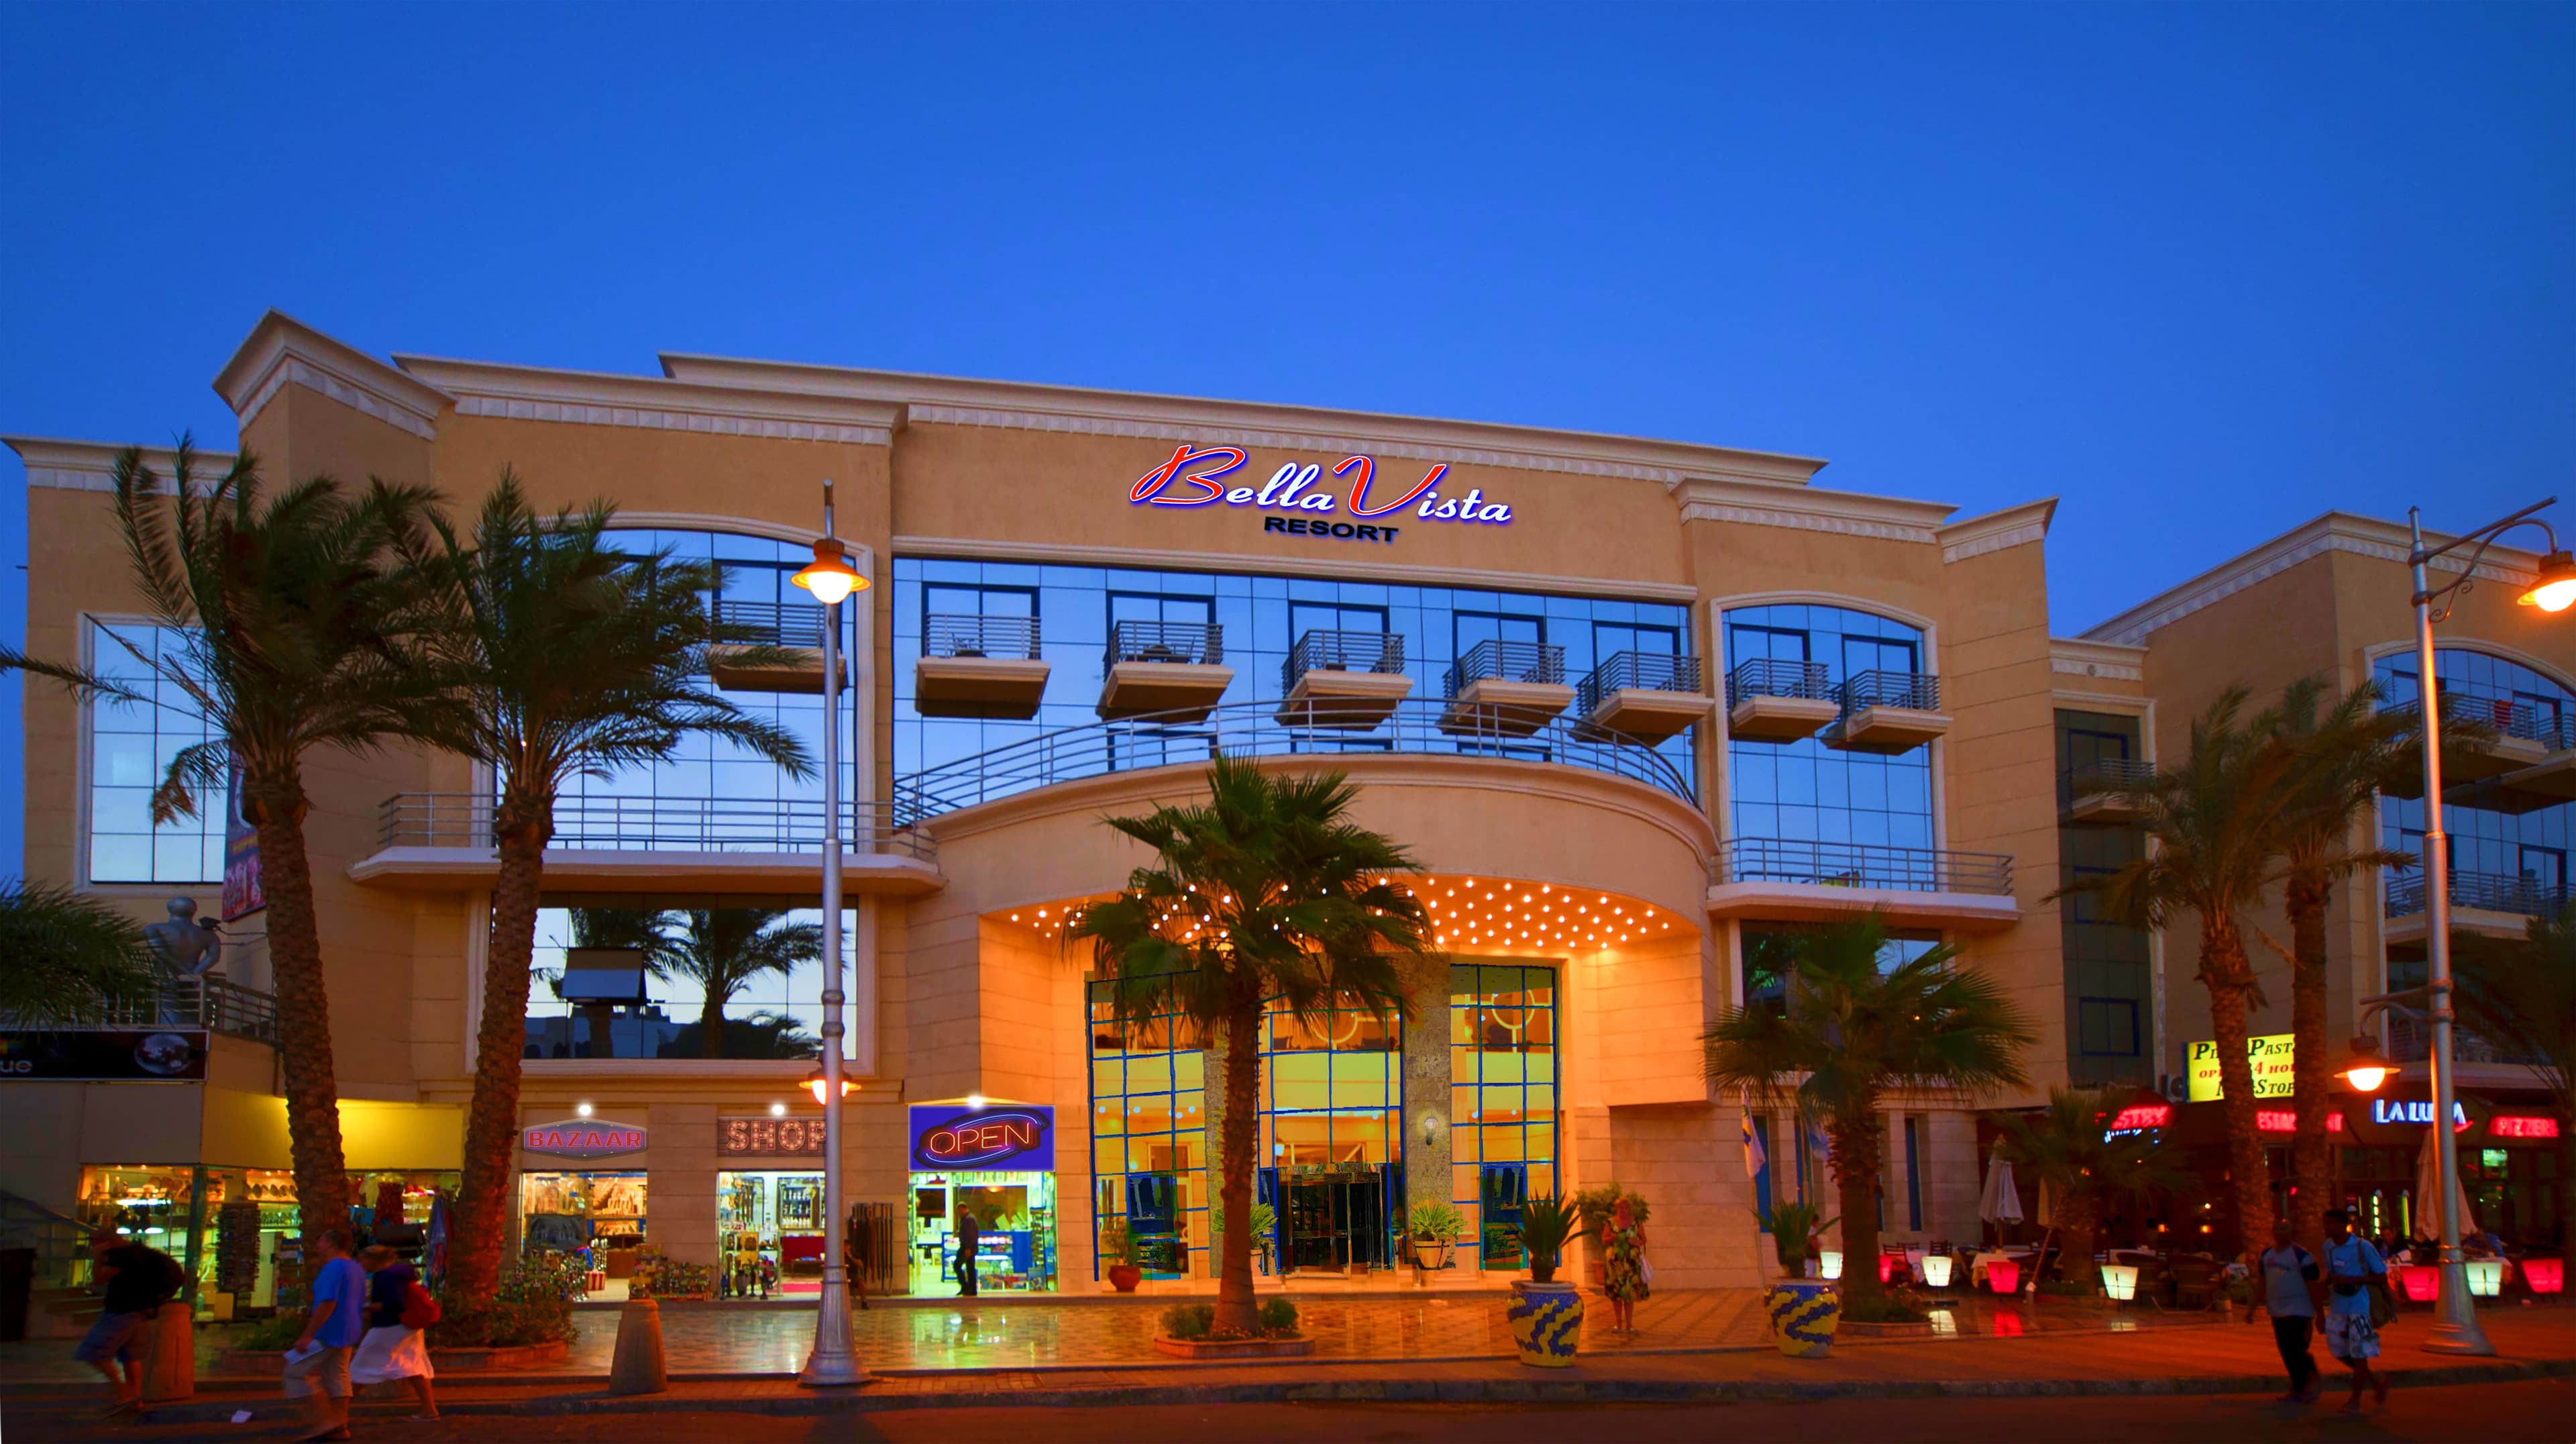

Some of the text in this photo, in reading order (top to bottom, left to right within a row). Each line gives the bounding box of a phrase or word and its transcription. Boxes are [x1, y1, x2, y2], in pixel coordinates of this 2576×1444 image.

[1130, 444, 1511, 522] Bella Vista
[1264, 516, 1399, 542] RESORT
[2249, 1039, 2294, 1055] PAST
[2408, 1101, 2467, 1124] LUA
[528, 1131, 642, 1148] BAZAAR
[726, 1120, 826, 1151] SHOP
[930, 1122, 1030, 1154] OPEN
